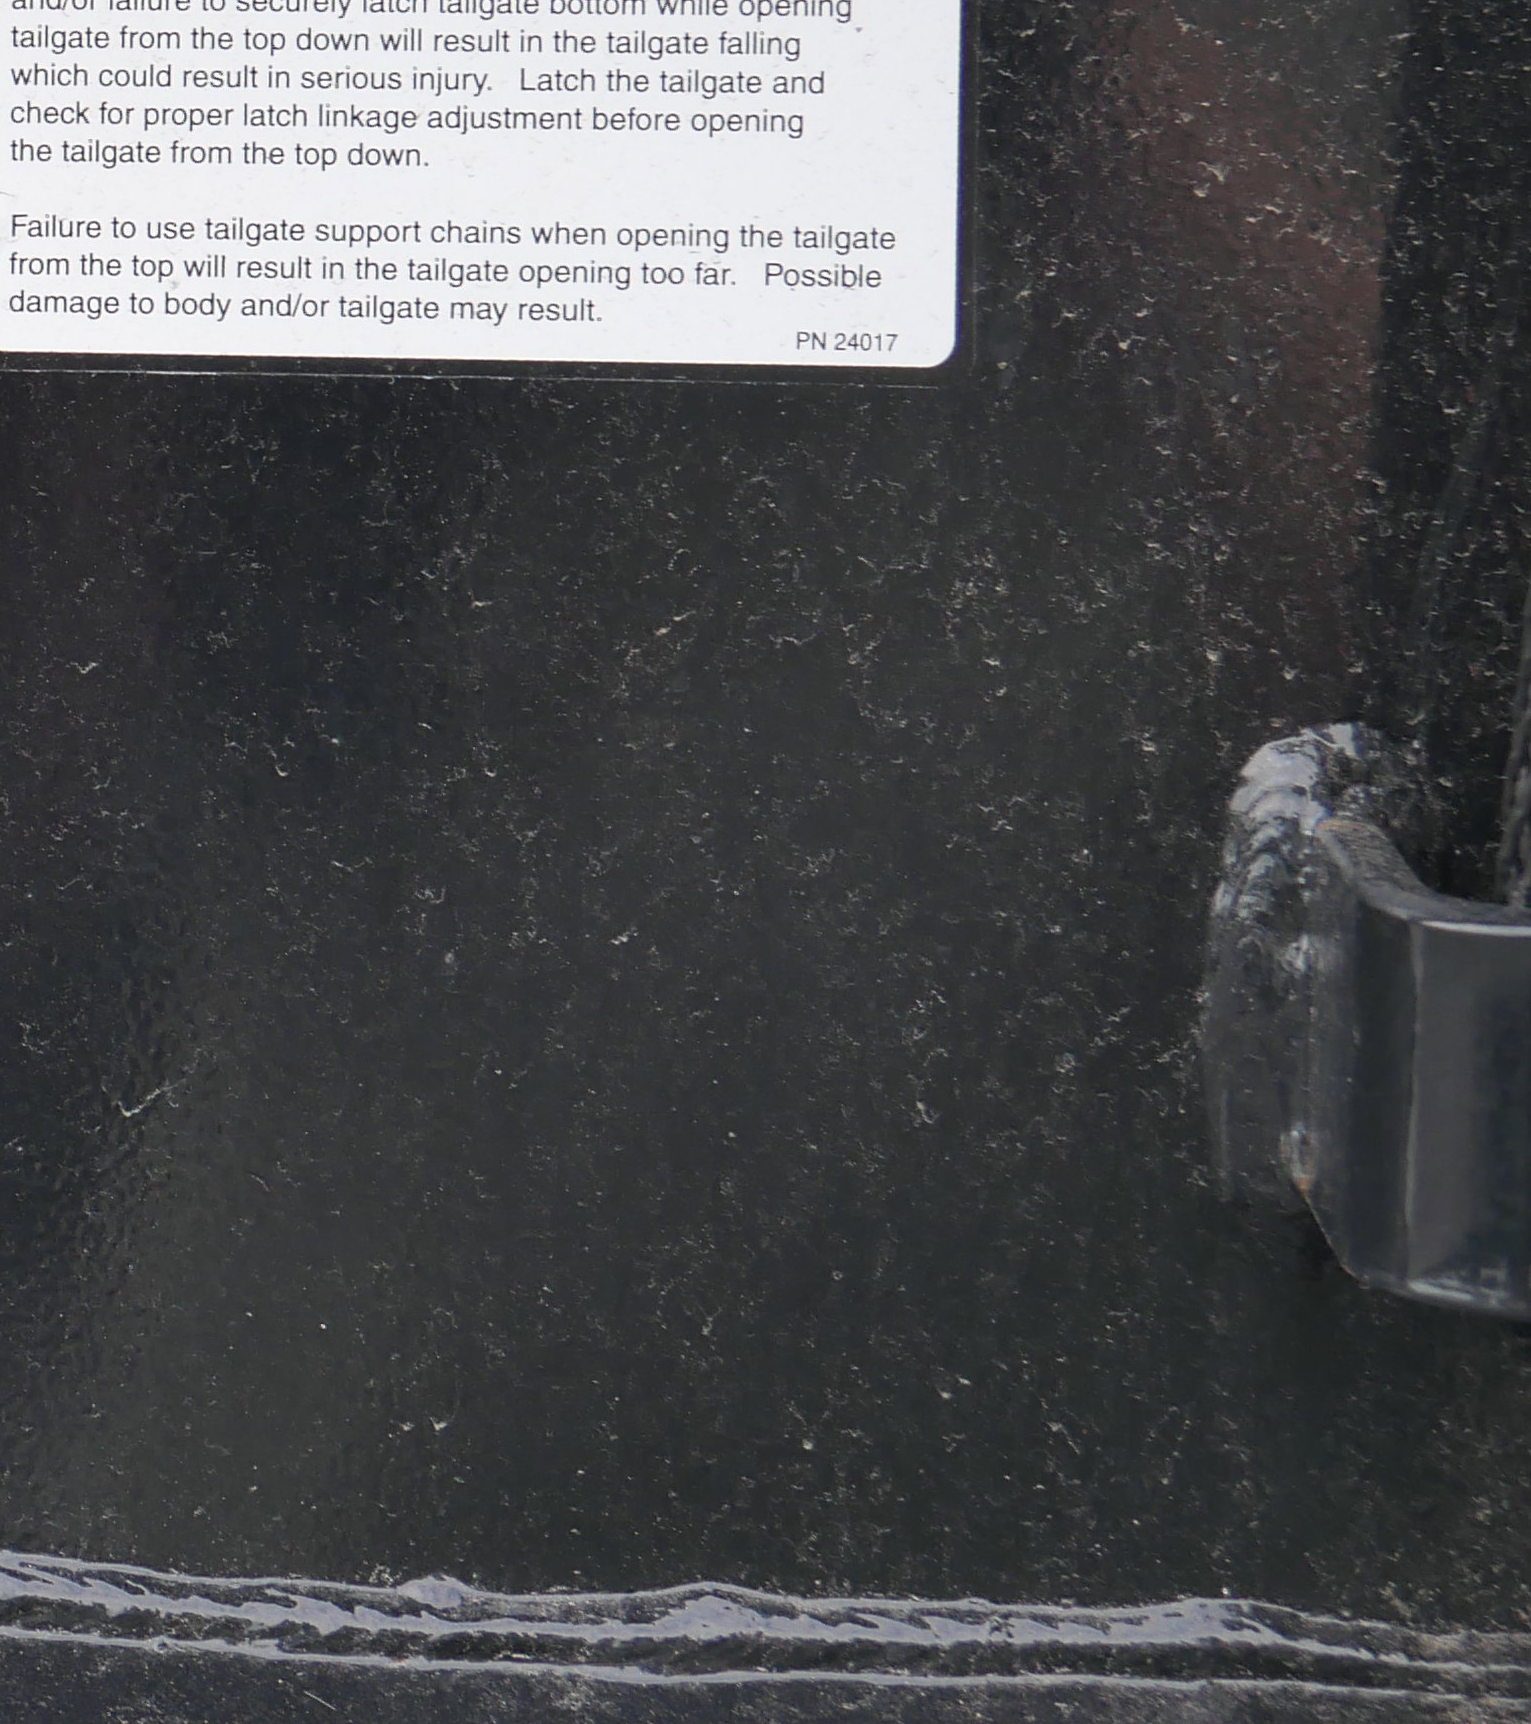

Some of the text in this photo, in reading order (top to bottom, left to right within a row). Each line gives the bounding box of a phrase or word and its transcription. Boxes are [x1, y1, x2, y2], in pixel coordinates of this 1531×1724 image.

[11, 101, 803, 139] check for proper latch linkage adjustment before opening
[12, 214, 895, 255] Failure to use tailgate support chains when opening the tailgate
[9, 290, 601, 326] damage to body and/or tailgate may result.
[797, 332, 898, 351] PN 24017
